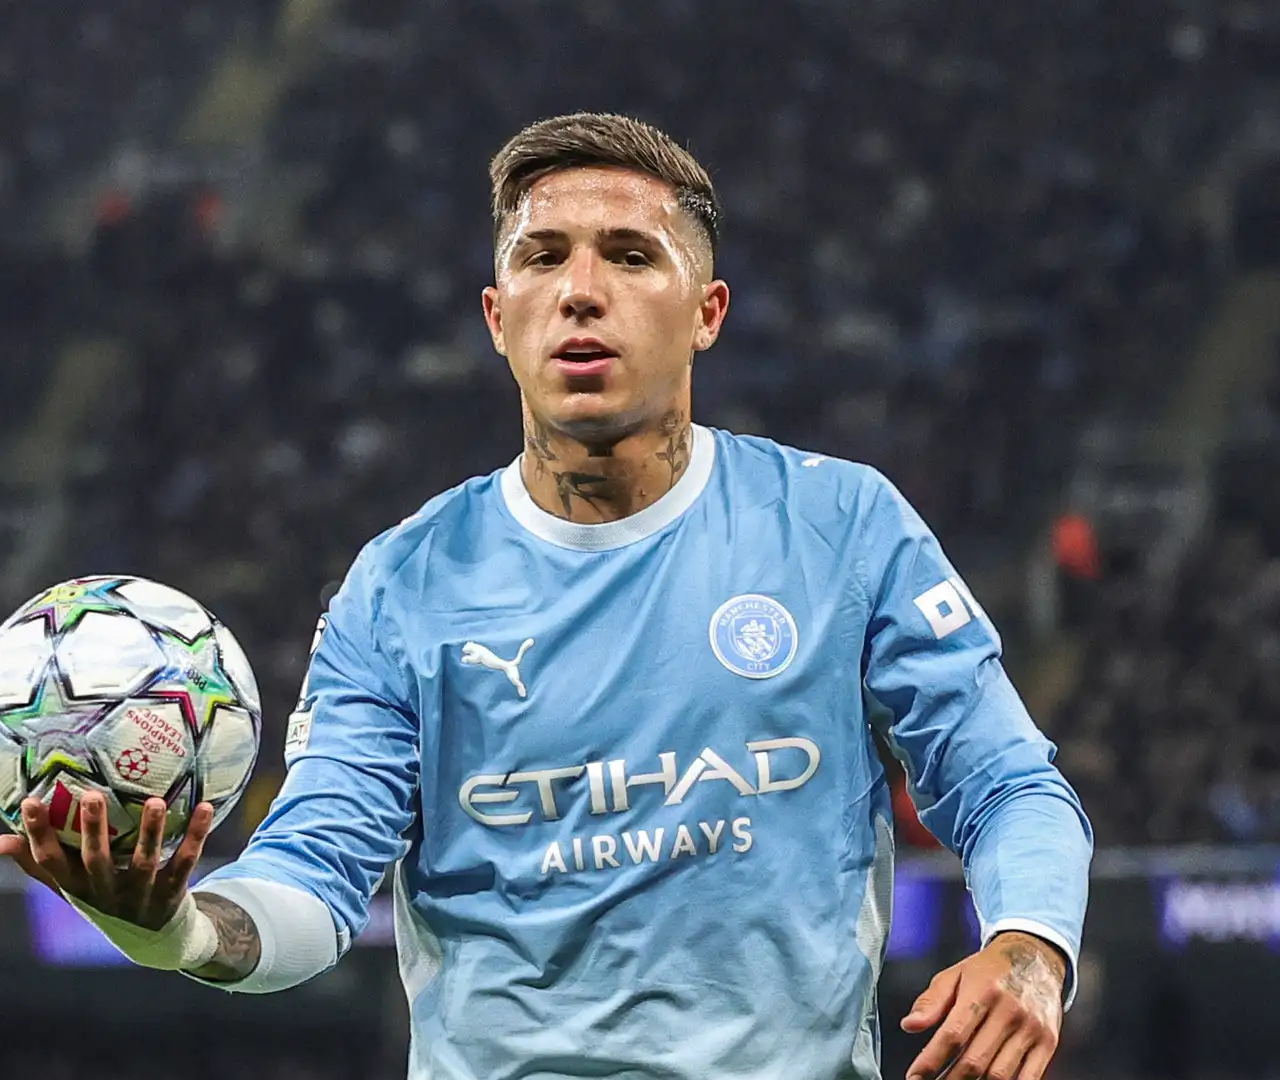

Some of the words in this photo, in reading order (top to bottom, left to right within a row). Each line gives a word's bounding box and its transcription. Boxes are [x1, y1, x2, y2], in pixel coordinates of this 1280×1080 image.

[186, 668, 207, 691] PRO
[126, 709, 187, 758] CHAMPIONS
[144, 708, 183, 741] LEAGUE
[457, 736, 822, 826] ETIHAD
[540, 816, 754, 875] AIRWAYS
